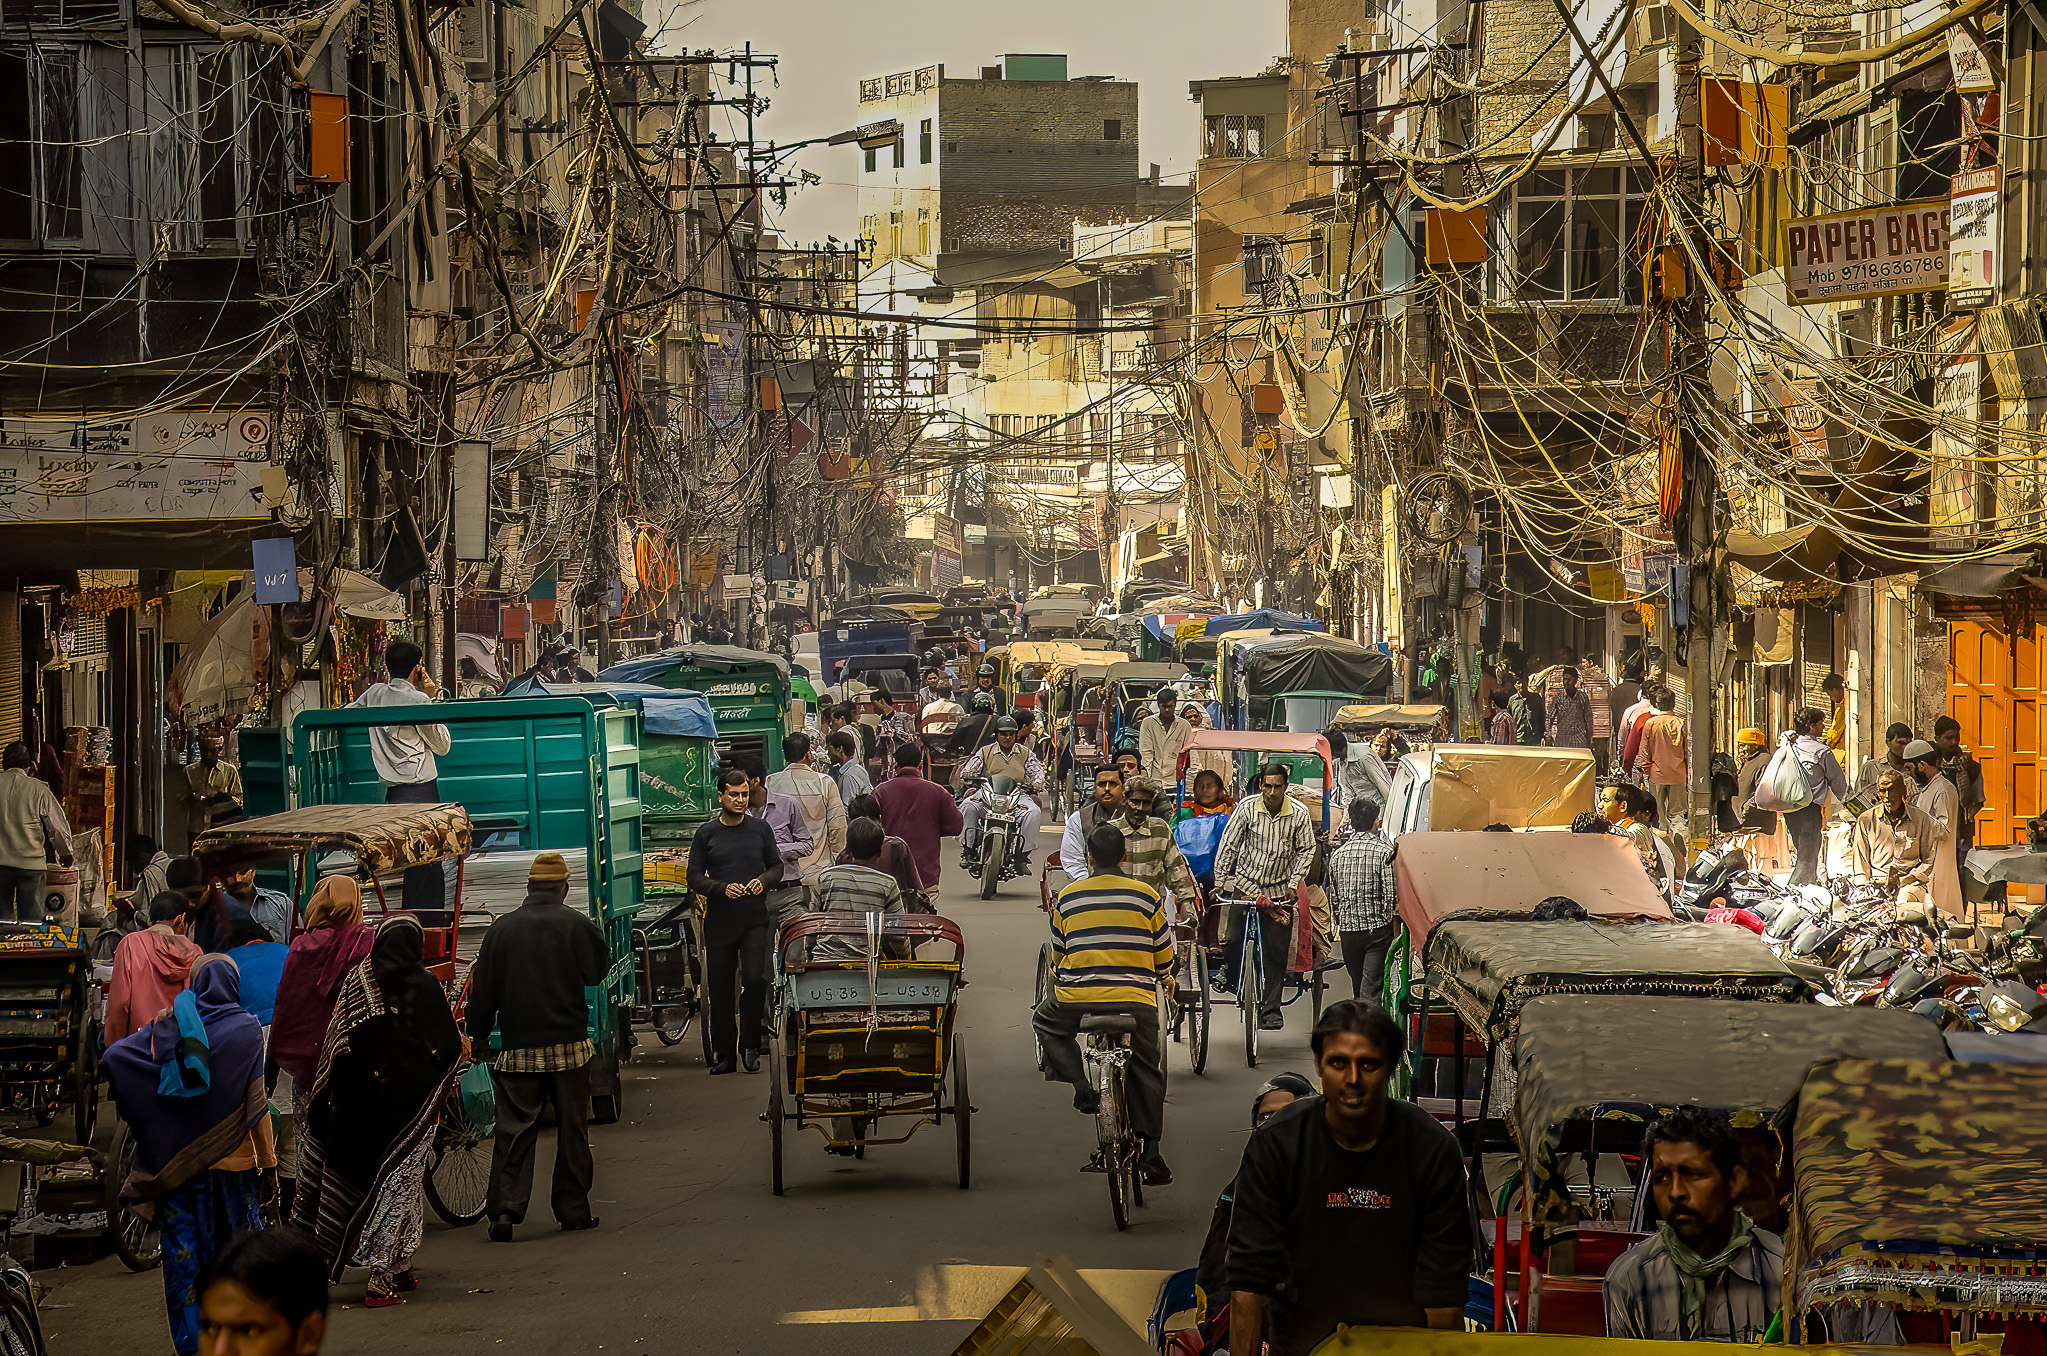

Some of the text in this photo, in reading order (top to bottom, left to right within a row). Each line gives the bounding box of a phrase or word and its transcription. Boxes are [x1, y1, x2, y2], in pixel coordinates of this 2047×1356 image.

[1789, 219, 1877, 267] PAPER
[1886, 210, 1950, 257] BAGS
[1808, 256, 1944, 285] Mob 9718636786
